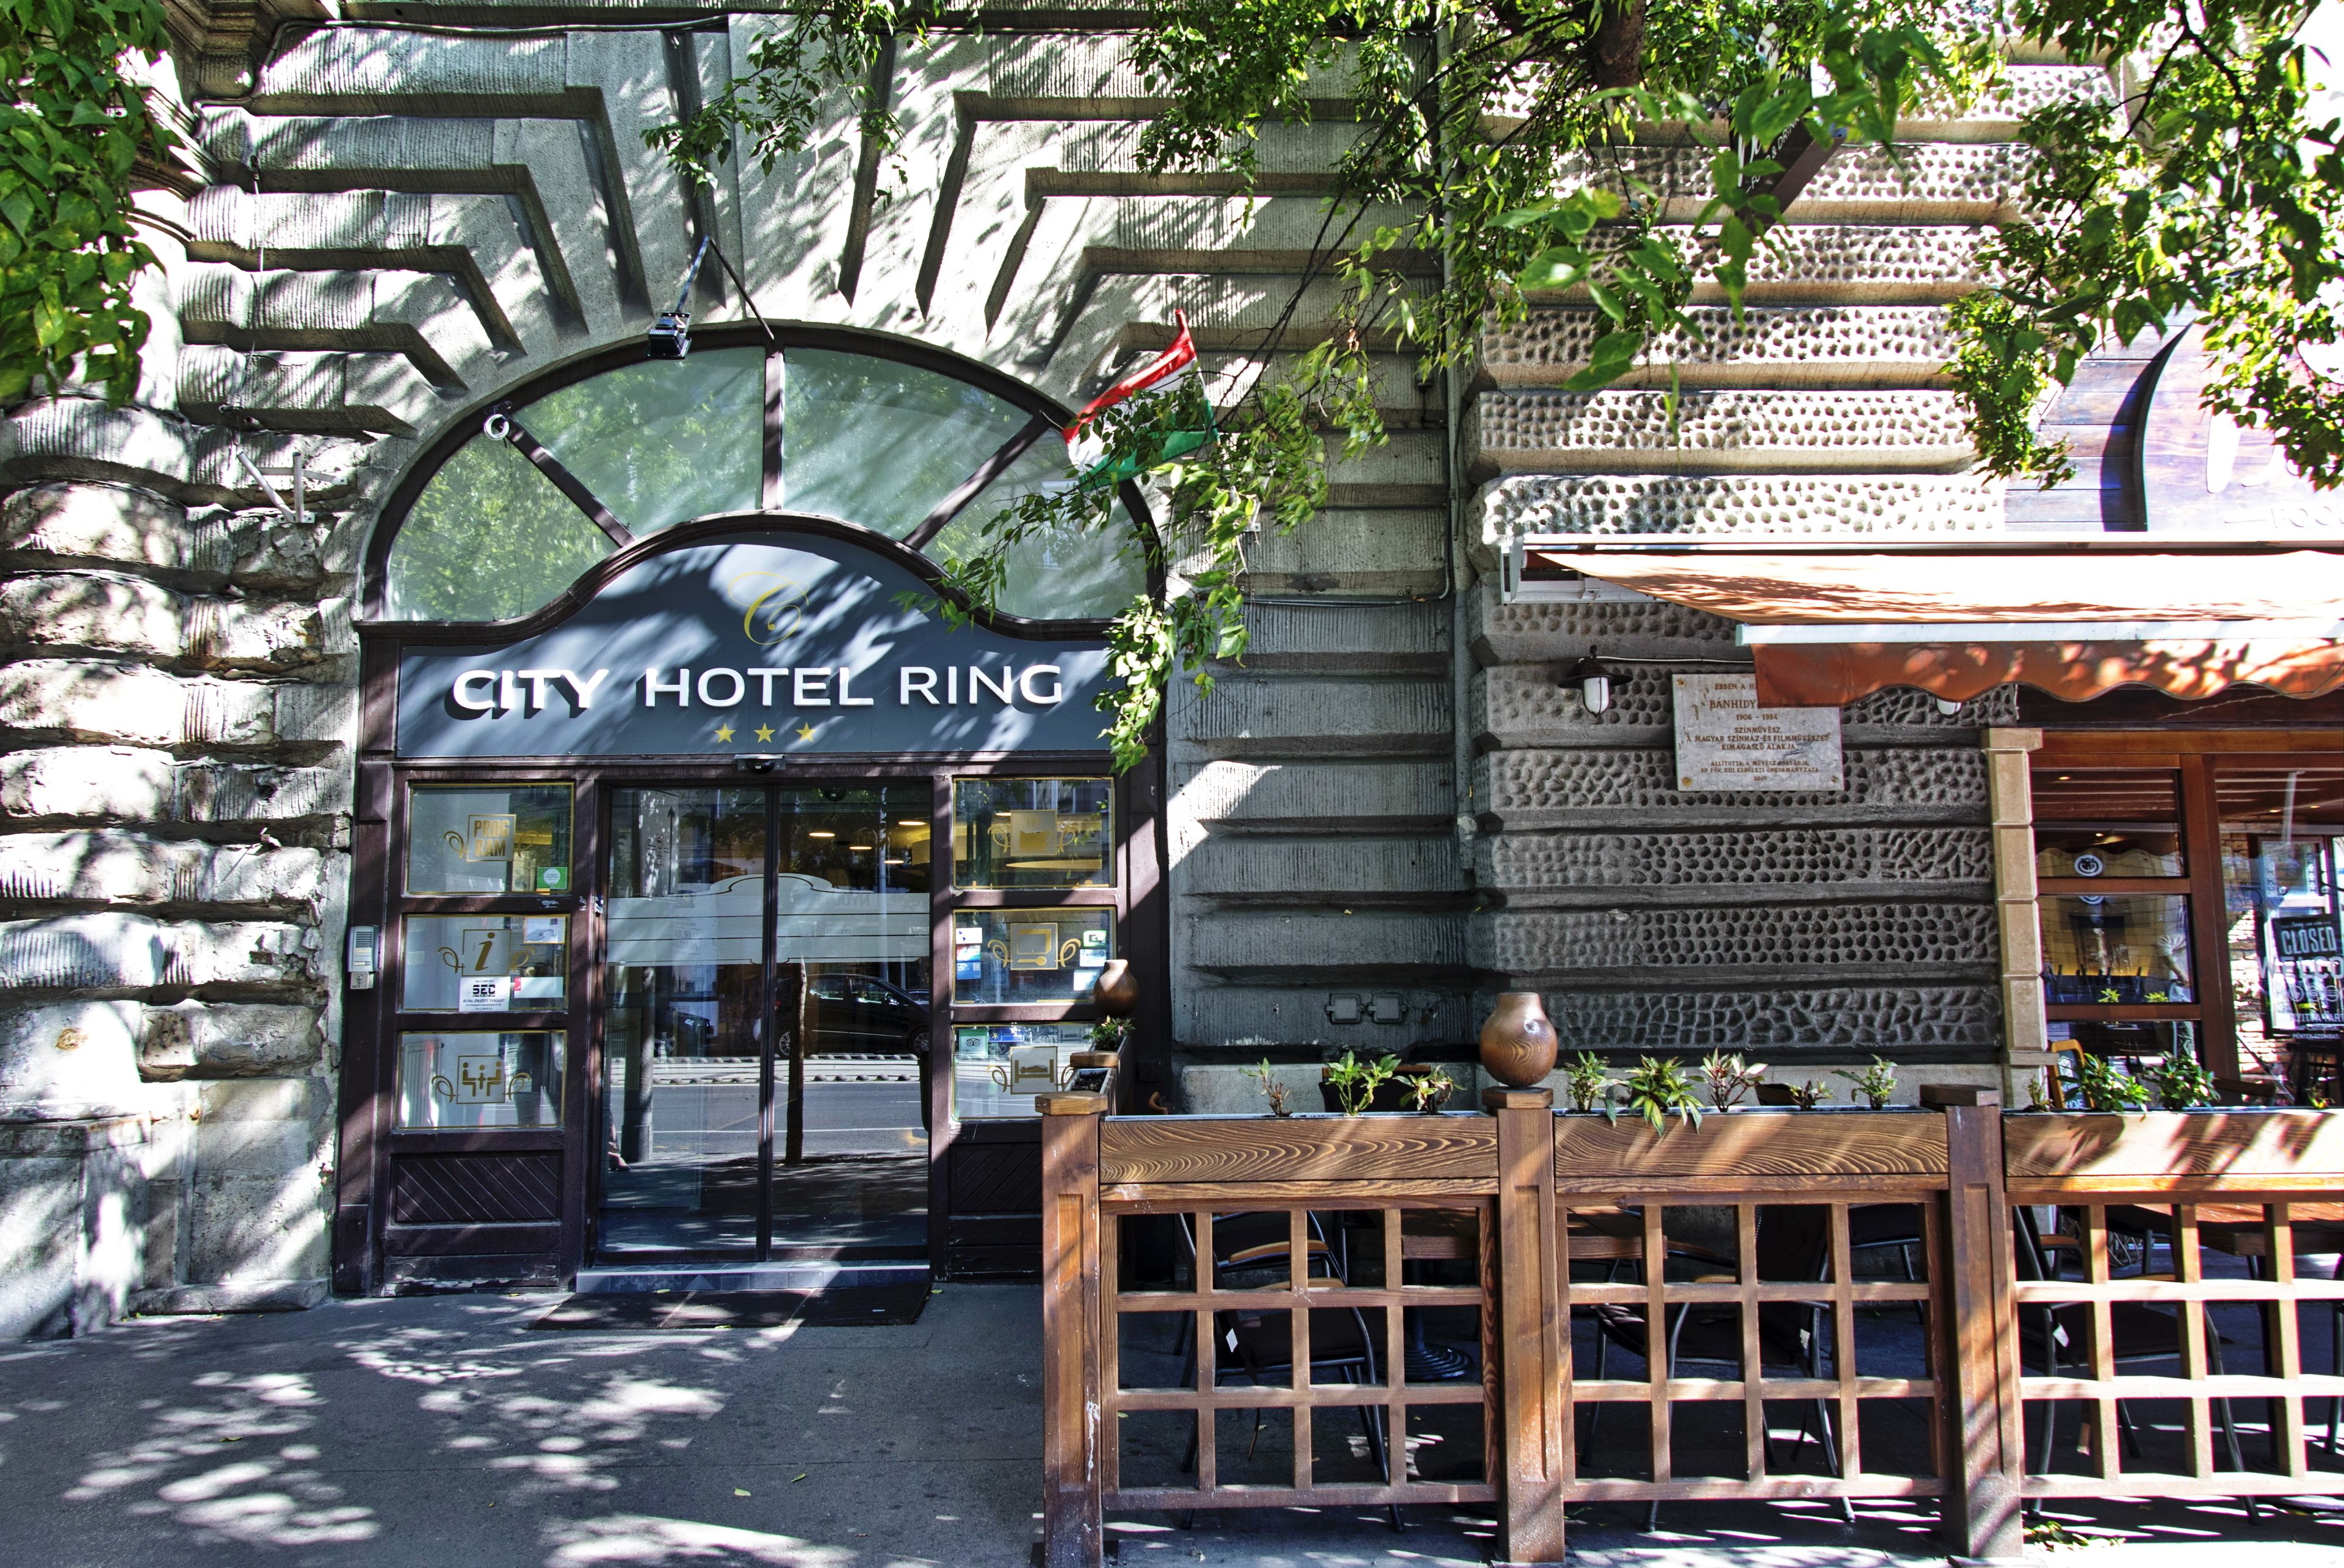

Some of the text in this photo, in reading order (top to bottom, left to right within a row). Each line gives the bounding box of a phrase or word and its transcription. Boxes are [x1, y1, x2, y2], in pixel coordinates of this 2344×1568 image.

[452, 664, 1063, 710] CITY HOTEL RING
[1709, 697, 1757, 709] BÁNHIDY
[474, 820, 510, 838] PROG
[475, 839, 506, 856] RAM
[2281, 926, 2337, 955] CLOSED
[472, 984, 496, 994] SEC
